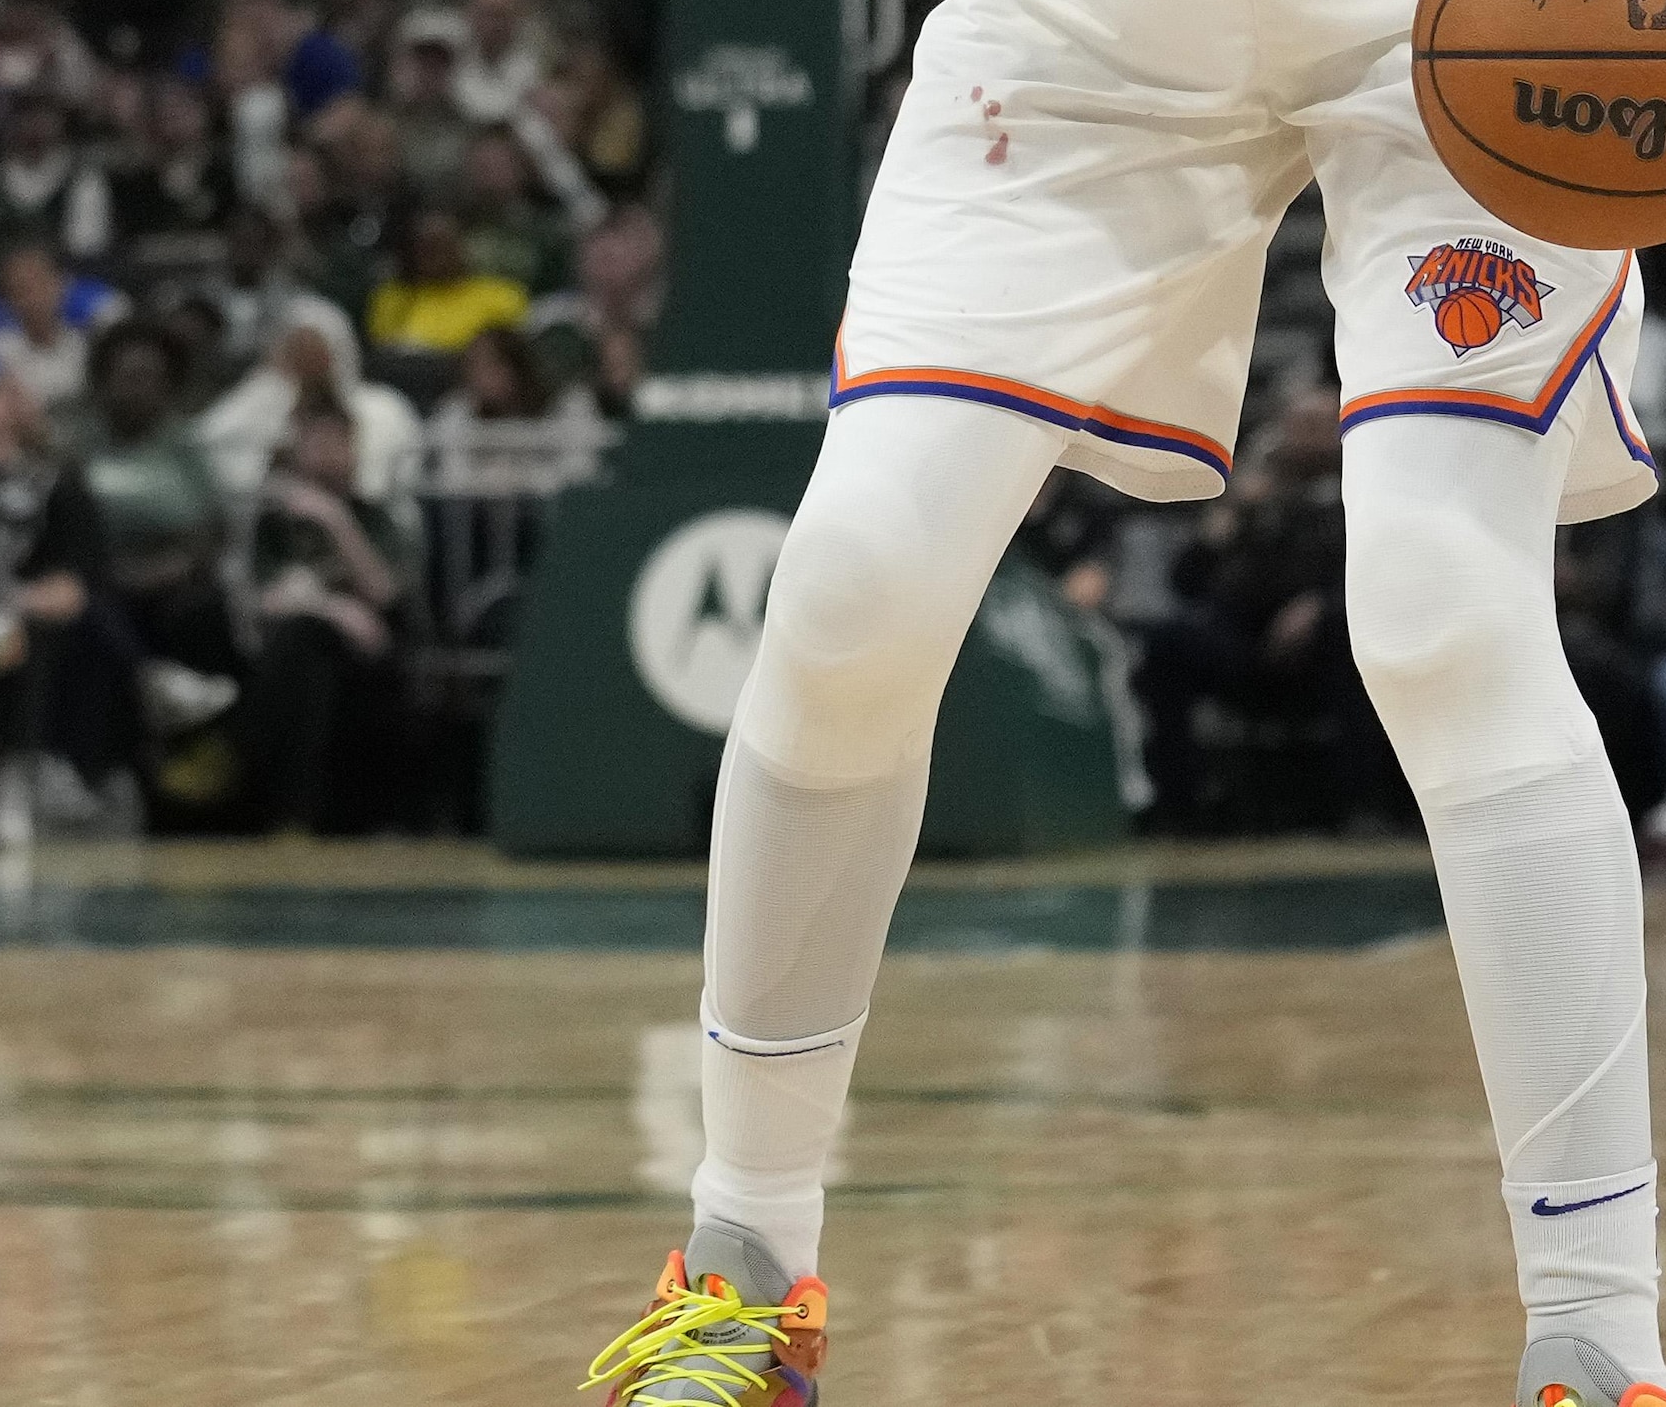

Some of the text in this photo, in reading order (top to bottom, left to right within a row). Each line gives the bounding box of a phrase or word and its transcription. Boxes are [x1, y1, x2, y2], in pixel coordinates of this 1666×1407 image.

[1456, 237, 1514, 262] NEW YORK
[1405, 243, 1543, 327] KNICKS
